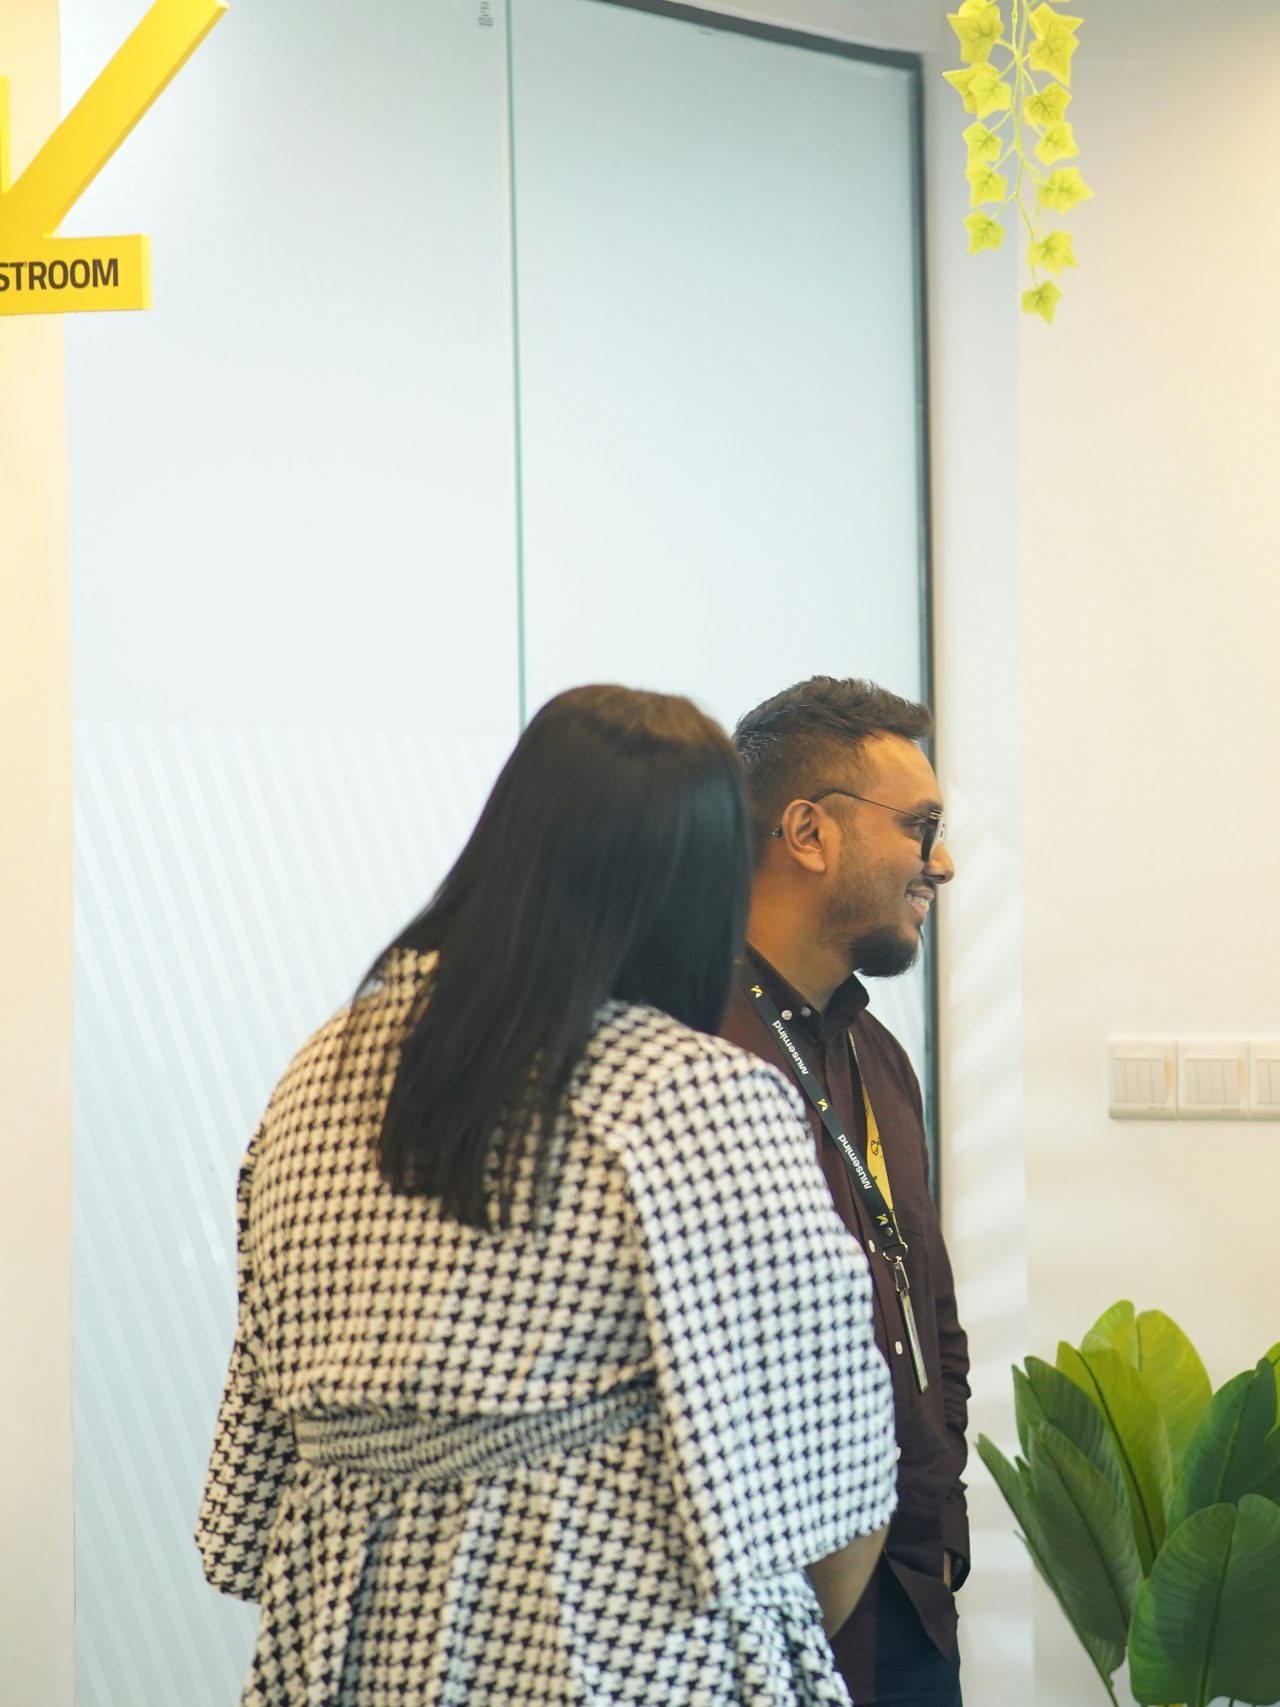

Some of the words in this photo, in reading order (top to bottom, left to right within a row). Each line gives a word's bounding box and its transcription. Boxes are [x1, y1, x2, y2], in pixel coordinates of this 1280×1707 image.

[0, 258, 119, 291] STROOM
[772, 1020, 809, 1075] Musemind
[837, 1134, 872, 1190] Musemind
